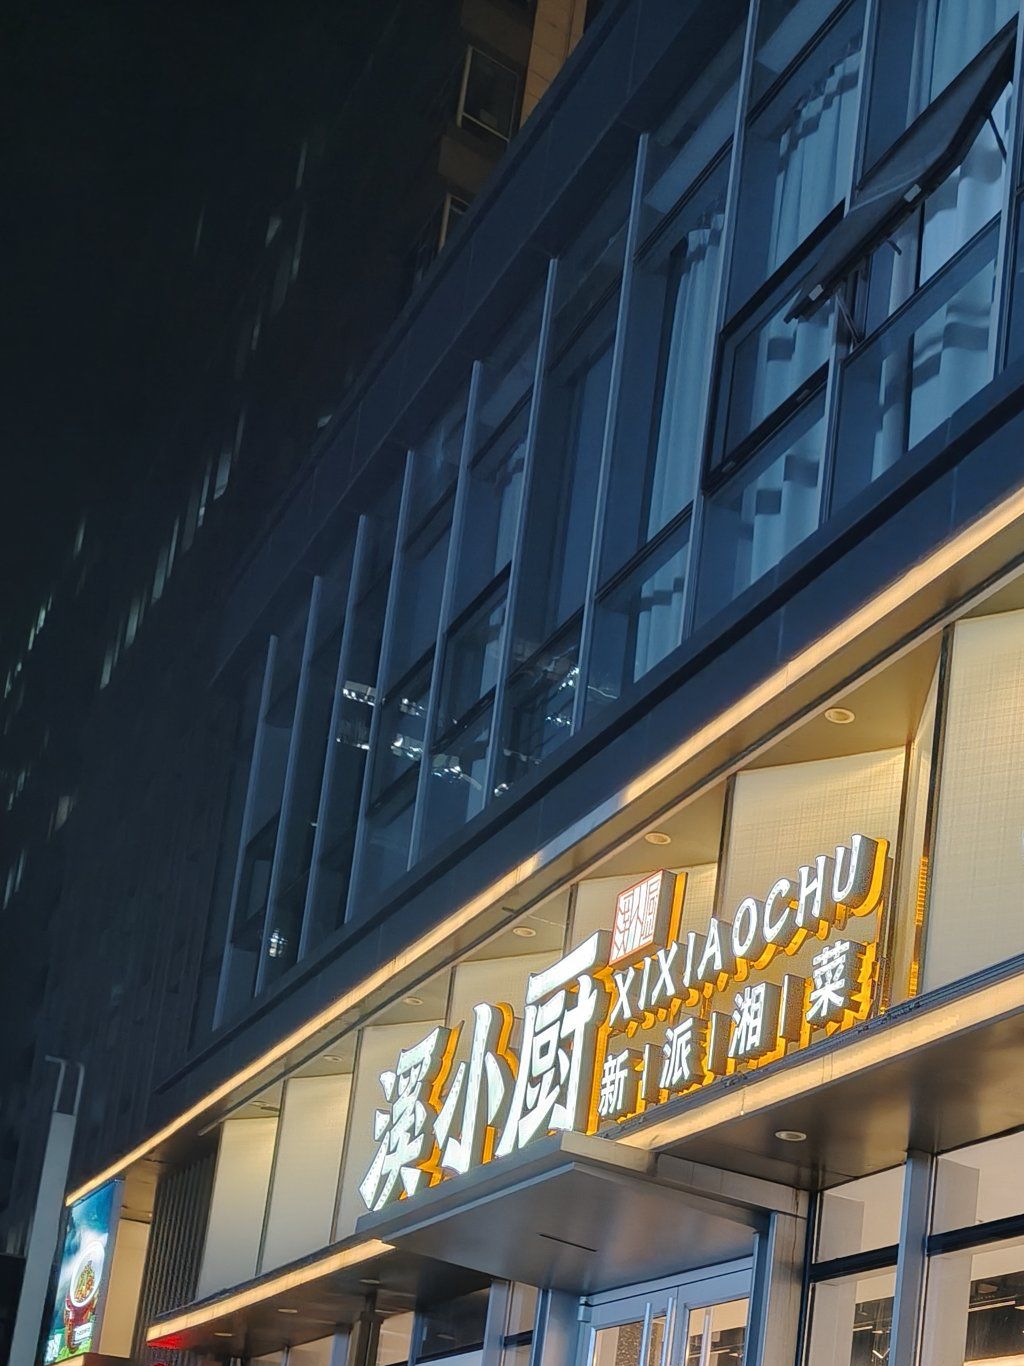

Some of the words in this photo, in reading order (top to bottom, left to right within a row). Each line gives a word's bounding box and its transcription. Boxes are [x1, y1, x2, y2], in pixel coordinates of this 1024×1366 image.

[610, 834, 878, 1025] XIXIAOCHU
[360, 930, 601, 1212] 溪小厨
